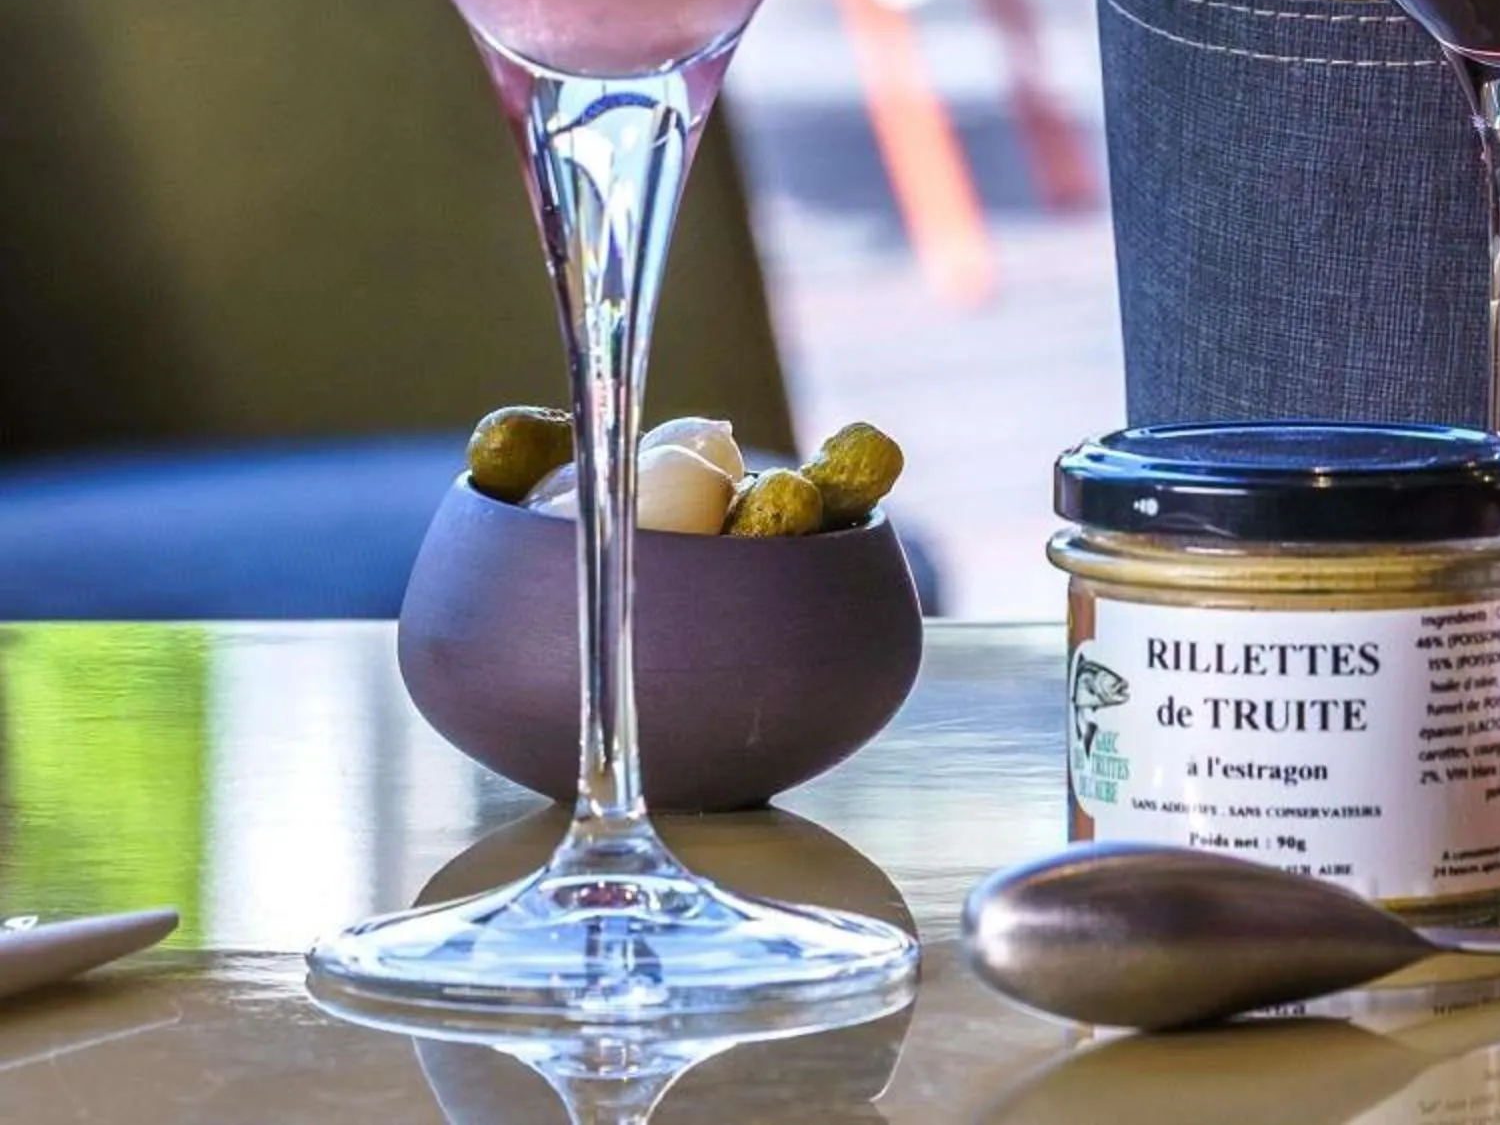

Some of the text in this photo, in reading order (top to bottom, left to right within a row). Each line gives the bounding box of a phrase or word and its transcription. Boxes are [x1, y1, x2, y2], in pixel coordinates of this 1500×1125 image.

[1147, 638, 1381, 676] RILLETTES
[1157, 695, 1368, 732] de TRUITE
[1187, 756, 1328, 786] à l'estragon
[1131, 797, 1157, 812] SANS
[1229, 805, 1261, 817] SANS
[1265, 805, 1382, 818] CONSERVATEURS
[1190, 831, 1229, 849] Poids
[1234, 837, 1258, 848] net
[1277, 836, 1306, 852] 90g
